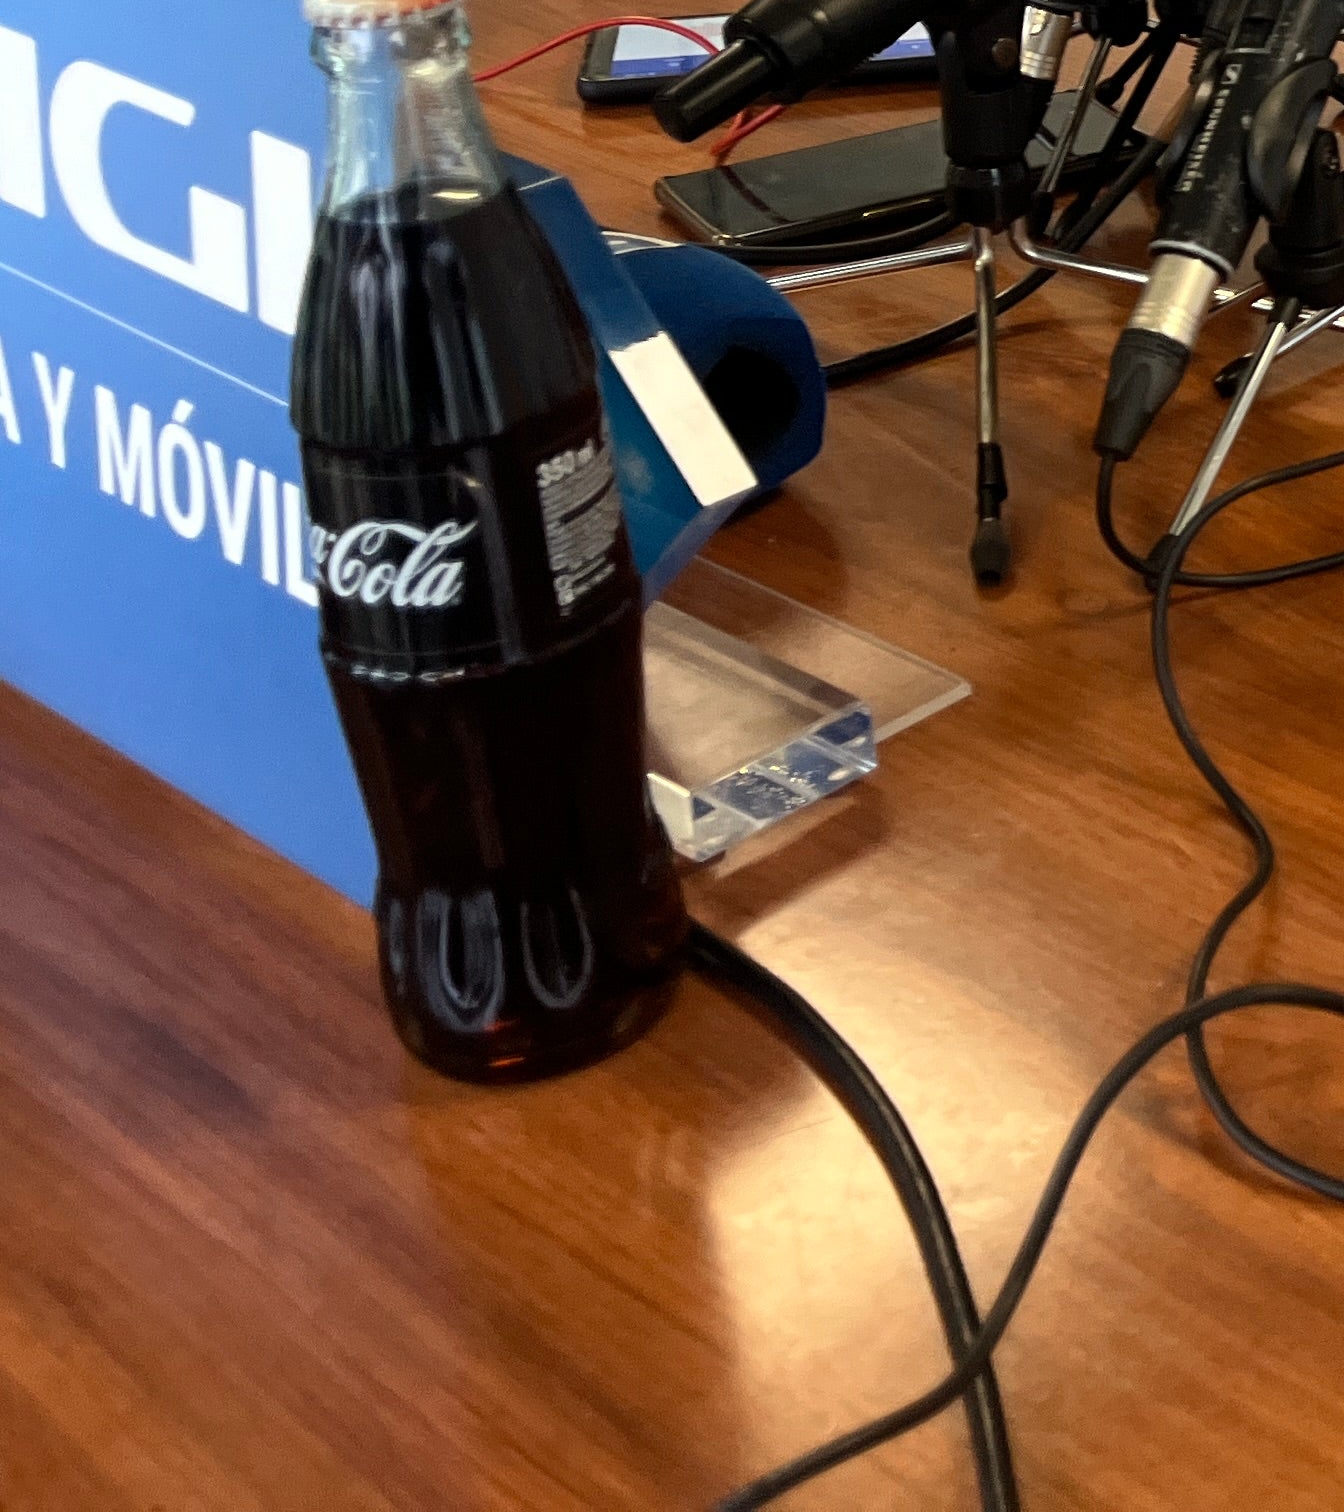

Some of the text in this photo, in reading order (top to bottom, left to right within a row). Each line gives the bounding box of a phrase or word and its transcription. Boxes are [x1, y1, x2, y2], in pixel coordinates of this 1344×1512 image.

[0, 26, 314, 335] IGI
[31, 351, 75, 470] Y
[95, 384, 320, 608] MÓVIL
[309, 518, 478, 608] a-Cola
